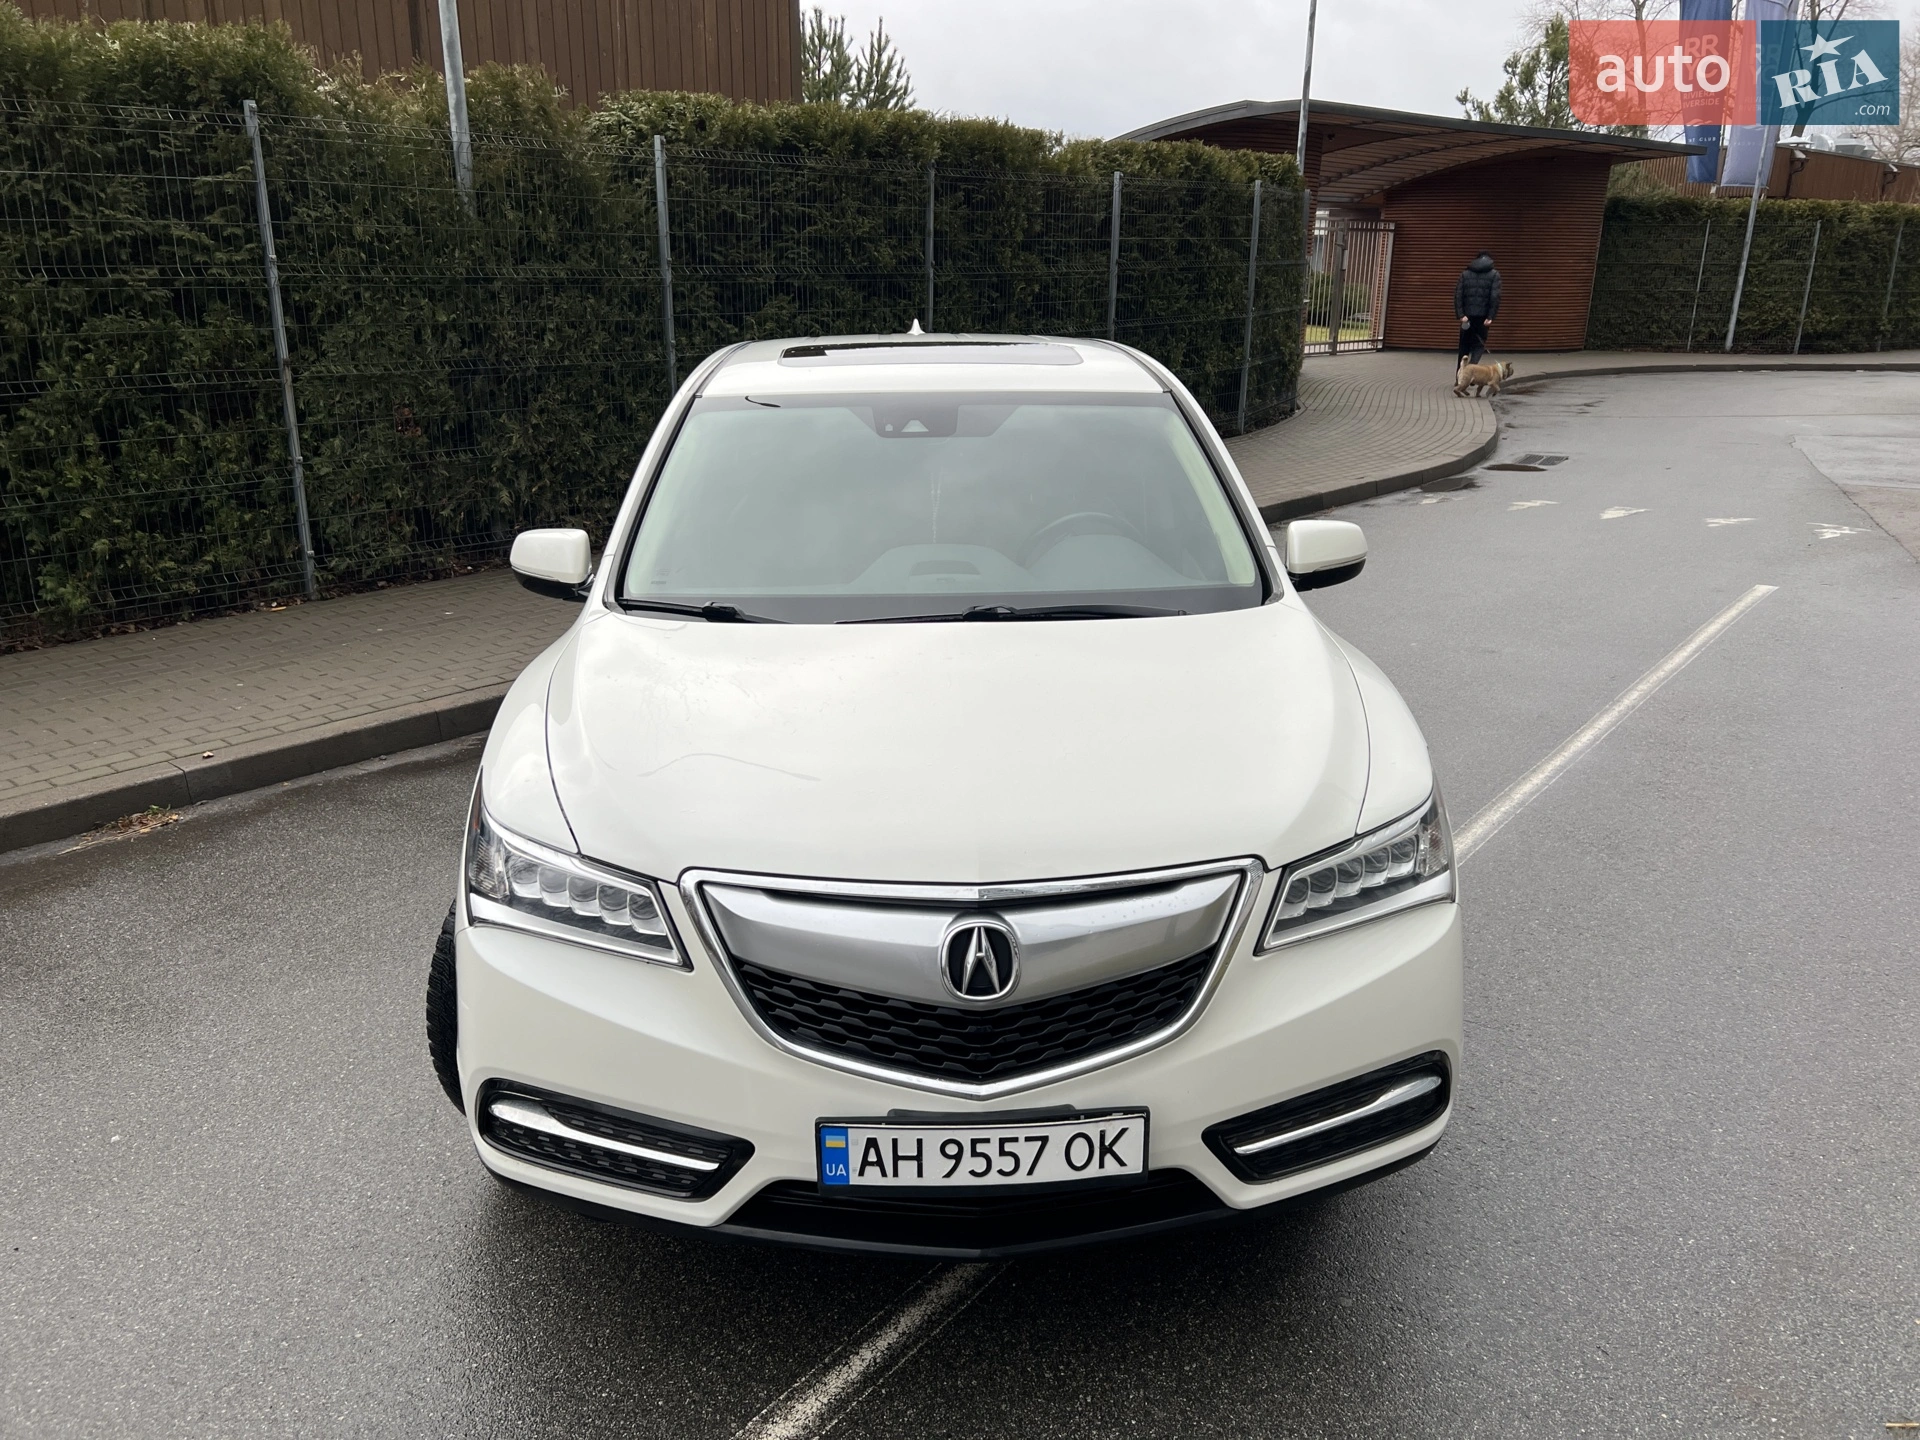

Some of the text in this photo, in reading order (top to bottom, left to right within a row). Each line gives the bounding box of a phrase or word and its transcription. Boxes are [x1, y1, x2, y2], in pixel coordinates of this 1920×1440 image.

[1684, 34, 1719, 57] RR
[826, 1127, 1130, 1178] UA AH 9557 OK
